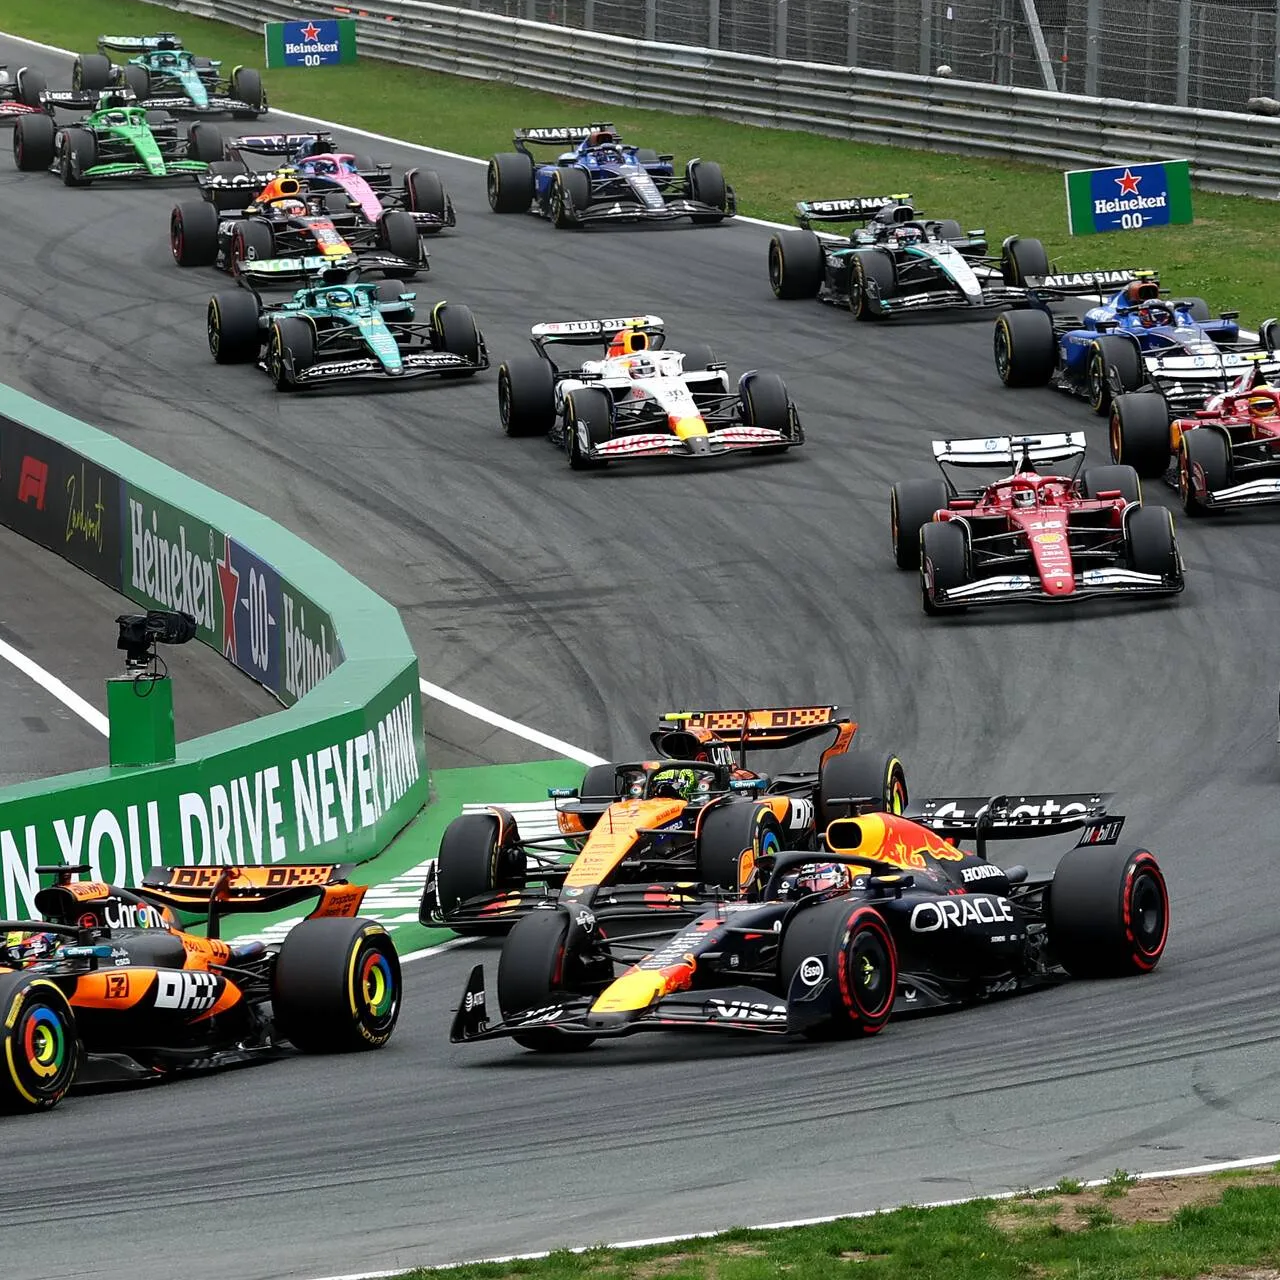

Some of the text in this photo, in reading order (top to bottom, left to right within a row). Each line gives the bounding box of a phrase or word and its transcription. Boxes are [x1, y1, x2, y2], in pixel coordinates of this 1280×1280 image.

[285, 42, 338, 54] Heineken
[528, 126, 602, 139] ATLASSIAN
[1094, 195, 1166, 214] Heineken
[1121, 213, 1143, 229] 0.0
[1044, 270, 1135, 287] ATLASSIAN
[606, 434, 666, 453] HUGO
[985, 439, 998, 451] hp
[129, 498, 269, 672] Heineken 0.0
[52, 800, 161, 895] YOU
[179, 765, 282, 867] DRIVE
[291, 734, 379, 851] NEVER
[377, 693, 418, 809] DRINK
[1081, 824, 1108, 844] Mobil
[961, 865, 1005, 882] HONDA
[910, 897, 1014, 933] ORACLE
[803, 964, 821, 977] Esso
[709, 999, 787, 1020] VISA
